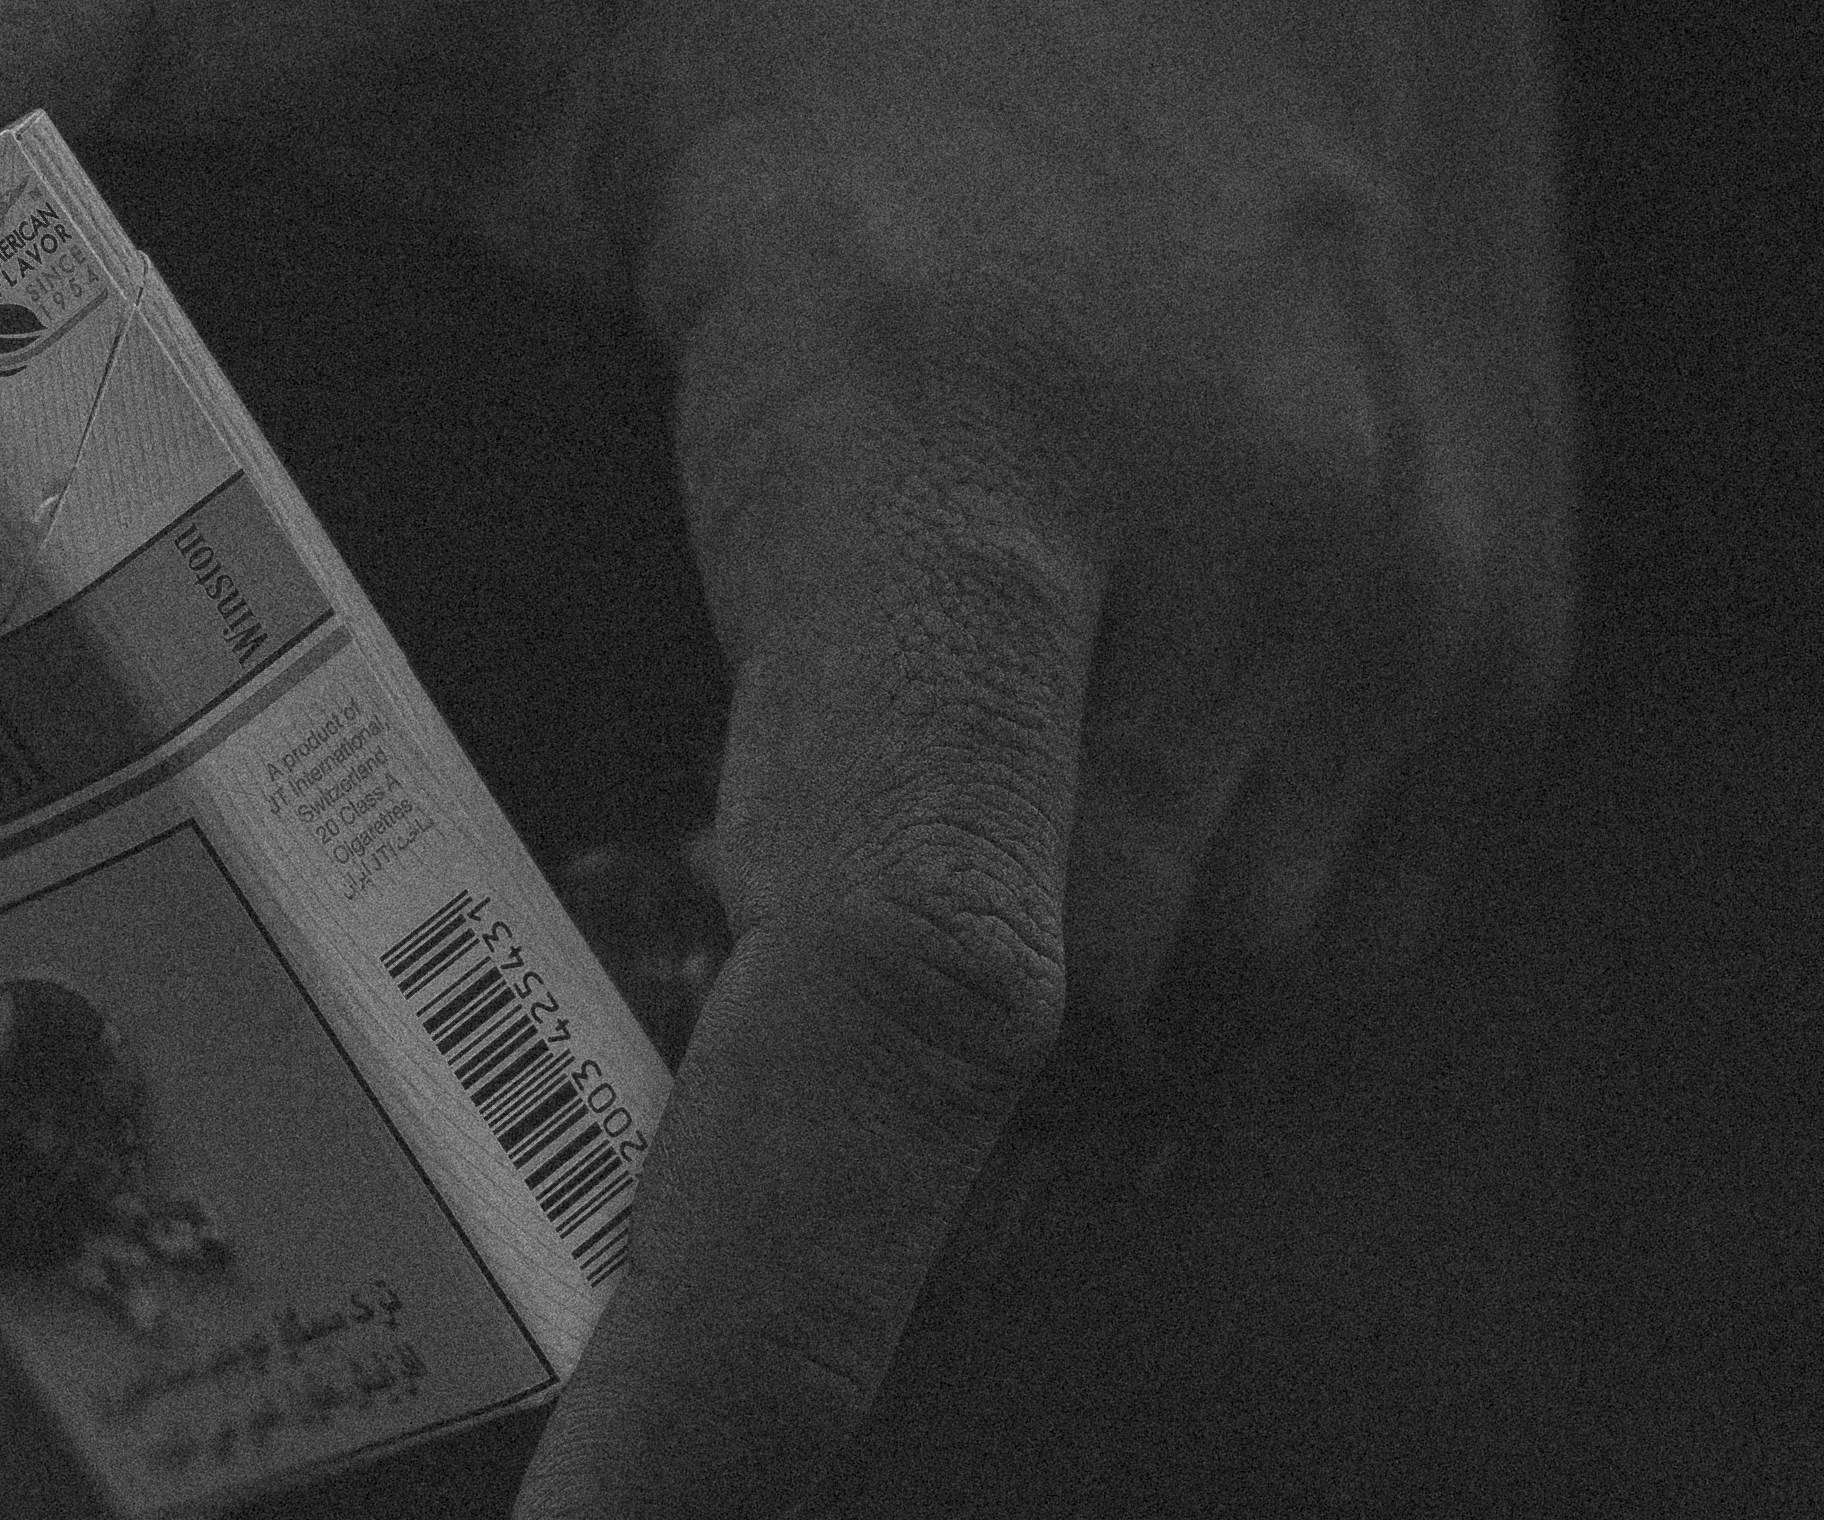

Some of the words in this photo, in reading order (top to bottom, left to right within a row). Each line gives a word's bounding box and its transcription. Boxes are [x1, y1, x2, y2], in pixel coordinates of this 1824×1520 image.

[25, 245, 87, 303] SINCE
[39, 267, 100, 321] 1954
[174, 522, 268, 669] Winston
[266, 762, 285, 782] A
[282, 712, 344, 773] product
[343, 696, 362, 721] of
[270, 786, 290, 816] JT
[288, 714, 392, 798] International,
[297, 744, 389, 823] Switzerland
[315, 818, 340, 845] 20
[339, 784, 385, 825] Class
[385, 772, 403, 792] A
[332, 798, 414, 864] Cigarettes
[571, 1058, 649, 1178] 2003
